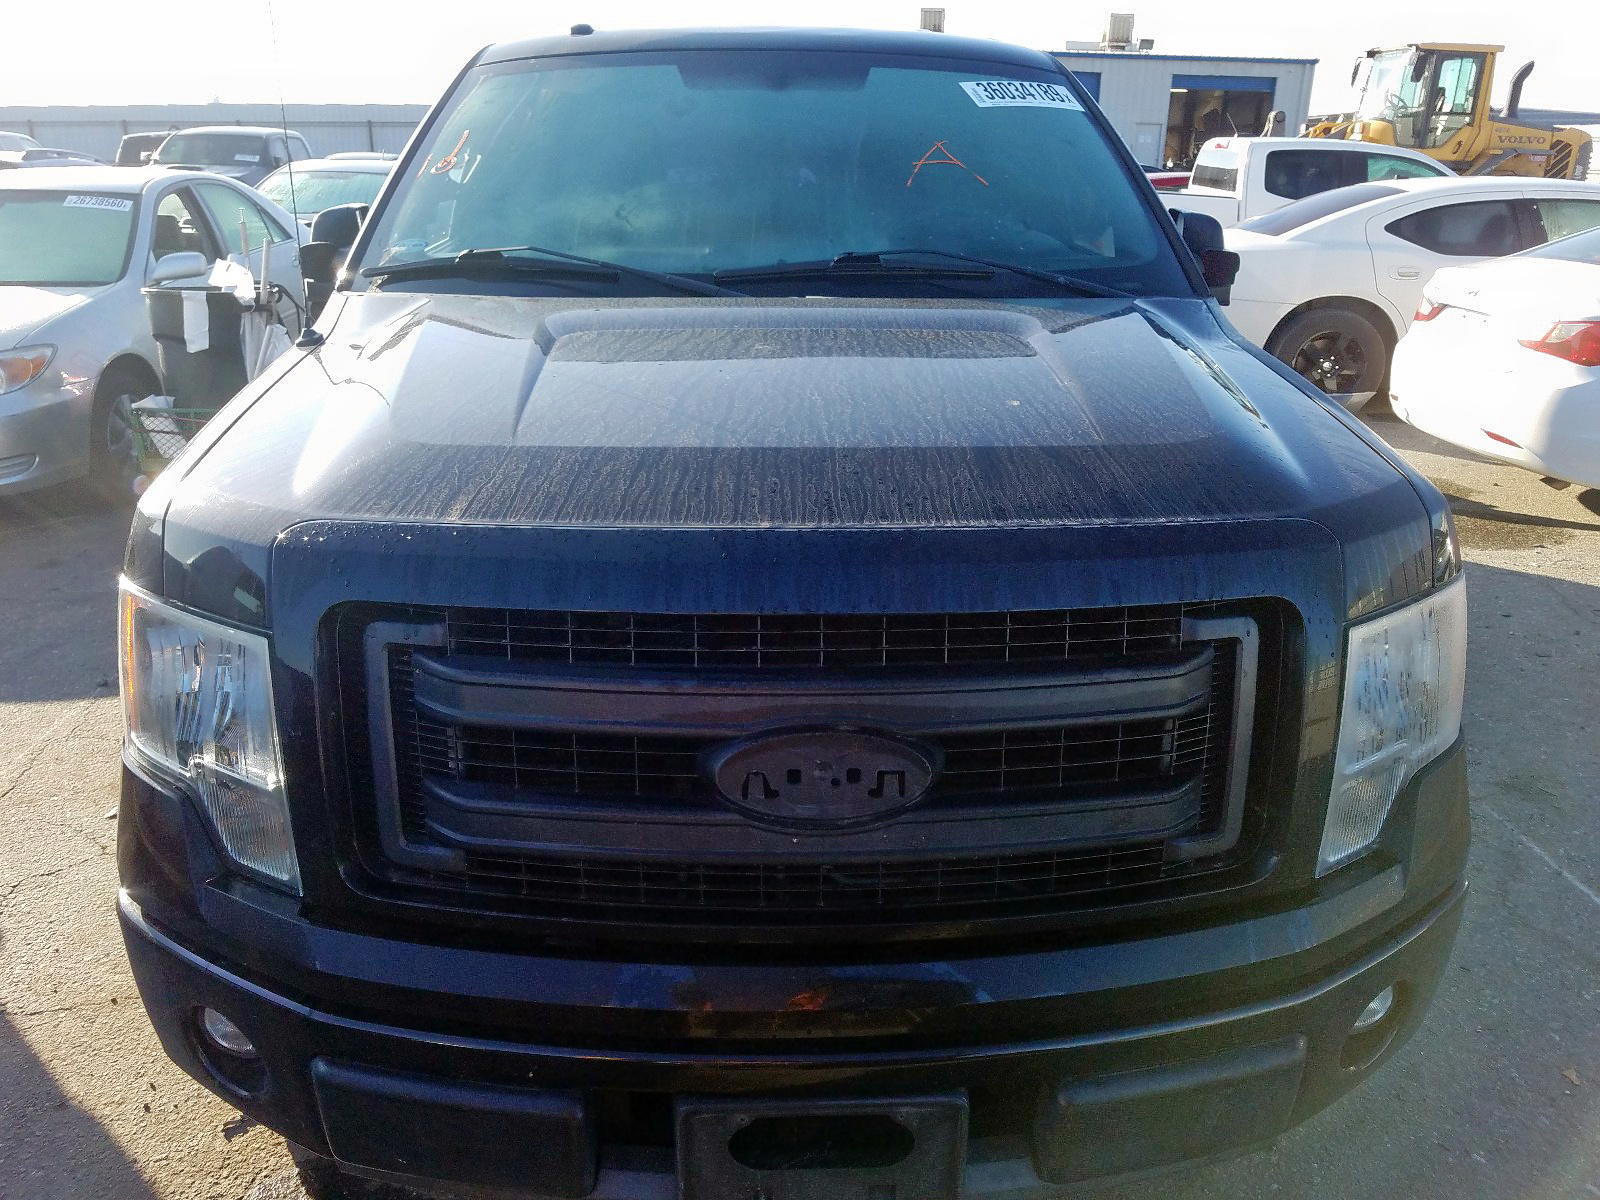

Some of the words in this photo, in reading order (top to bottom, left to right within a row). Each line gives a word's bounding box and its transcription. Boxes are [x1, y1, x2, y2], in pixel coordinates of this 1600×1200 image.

[976, 81, 1065, 103] 36034189
[1498, 135, 1545, 145] VOLVO
[905, 140, 989, 187] A
